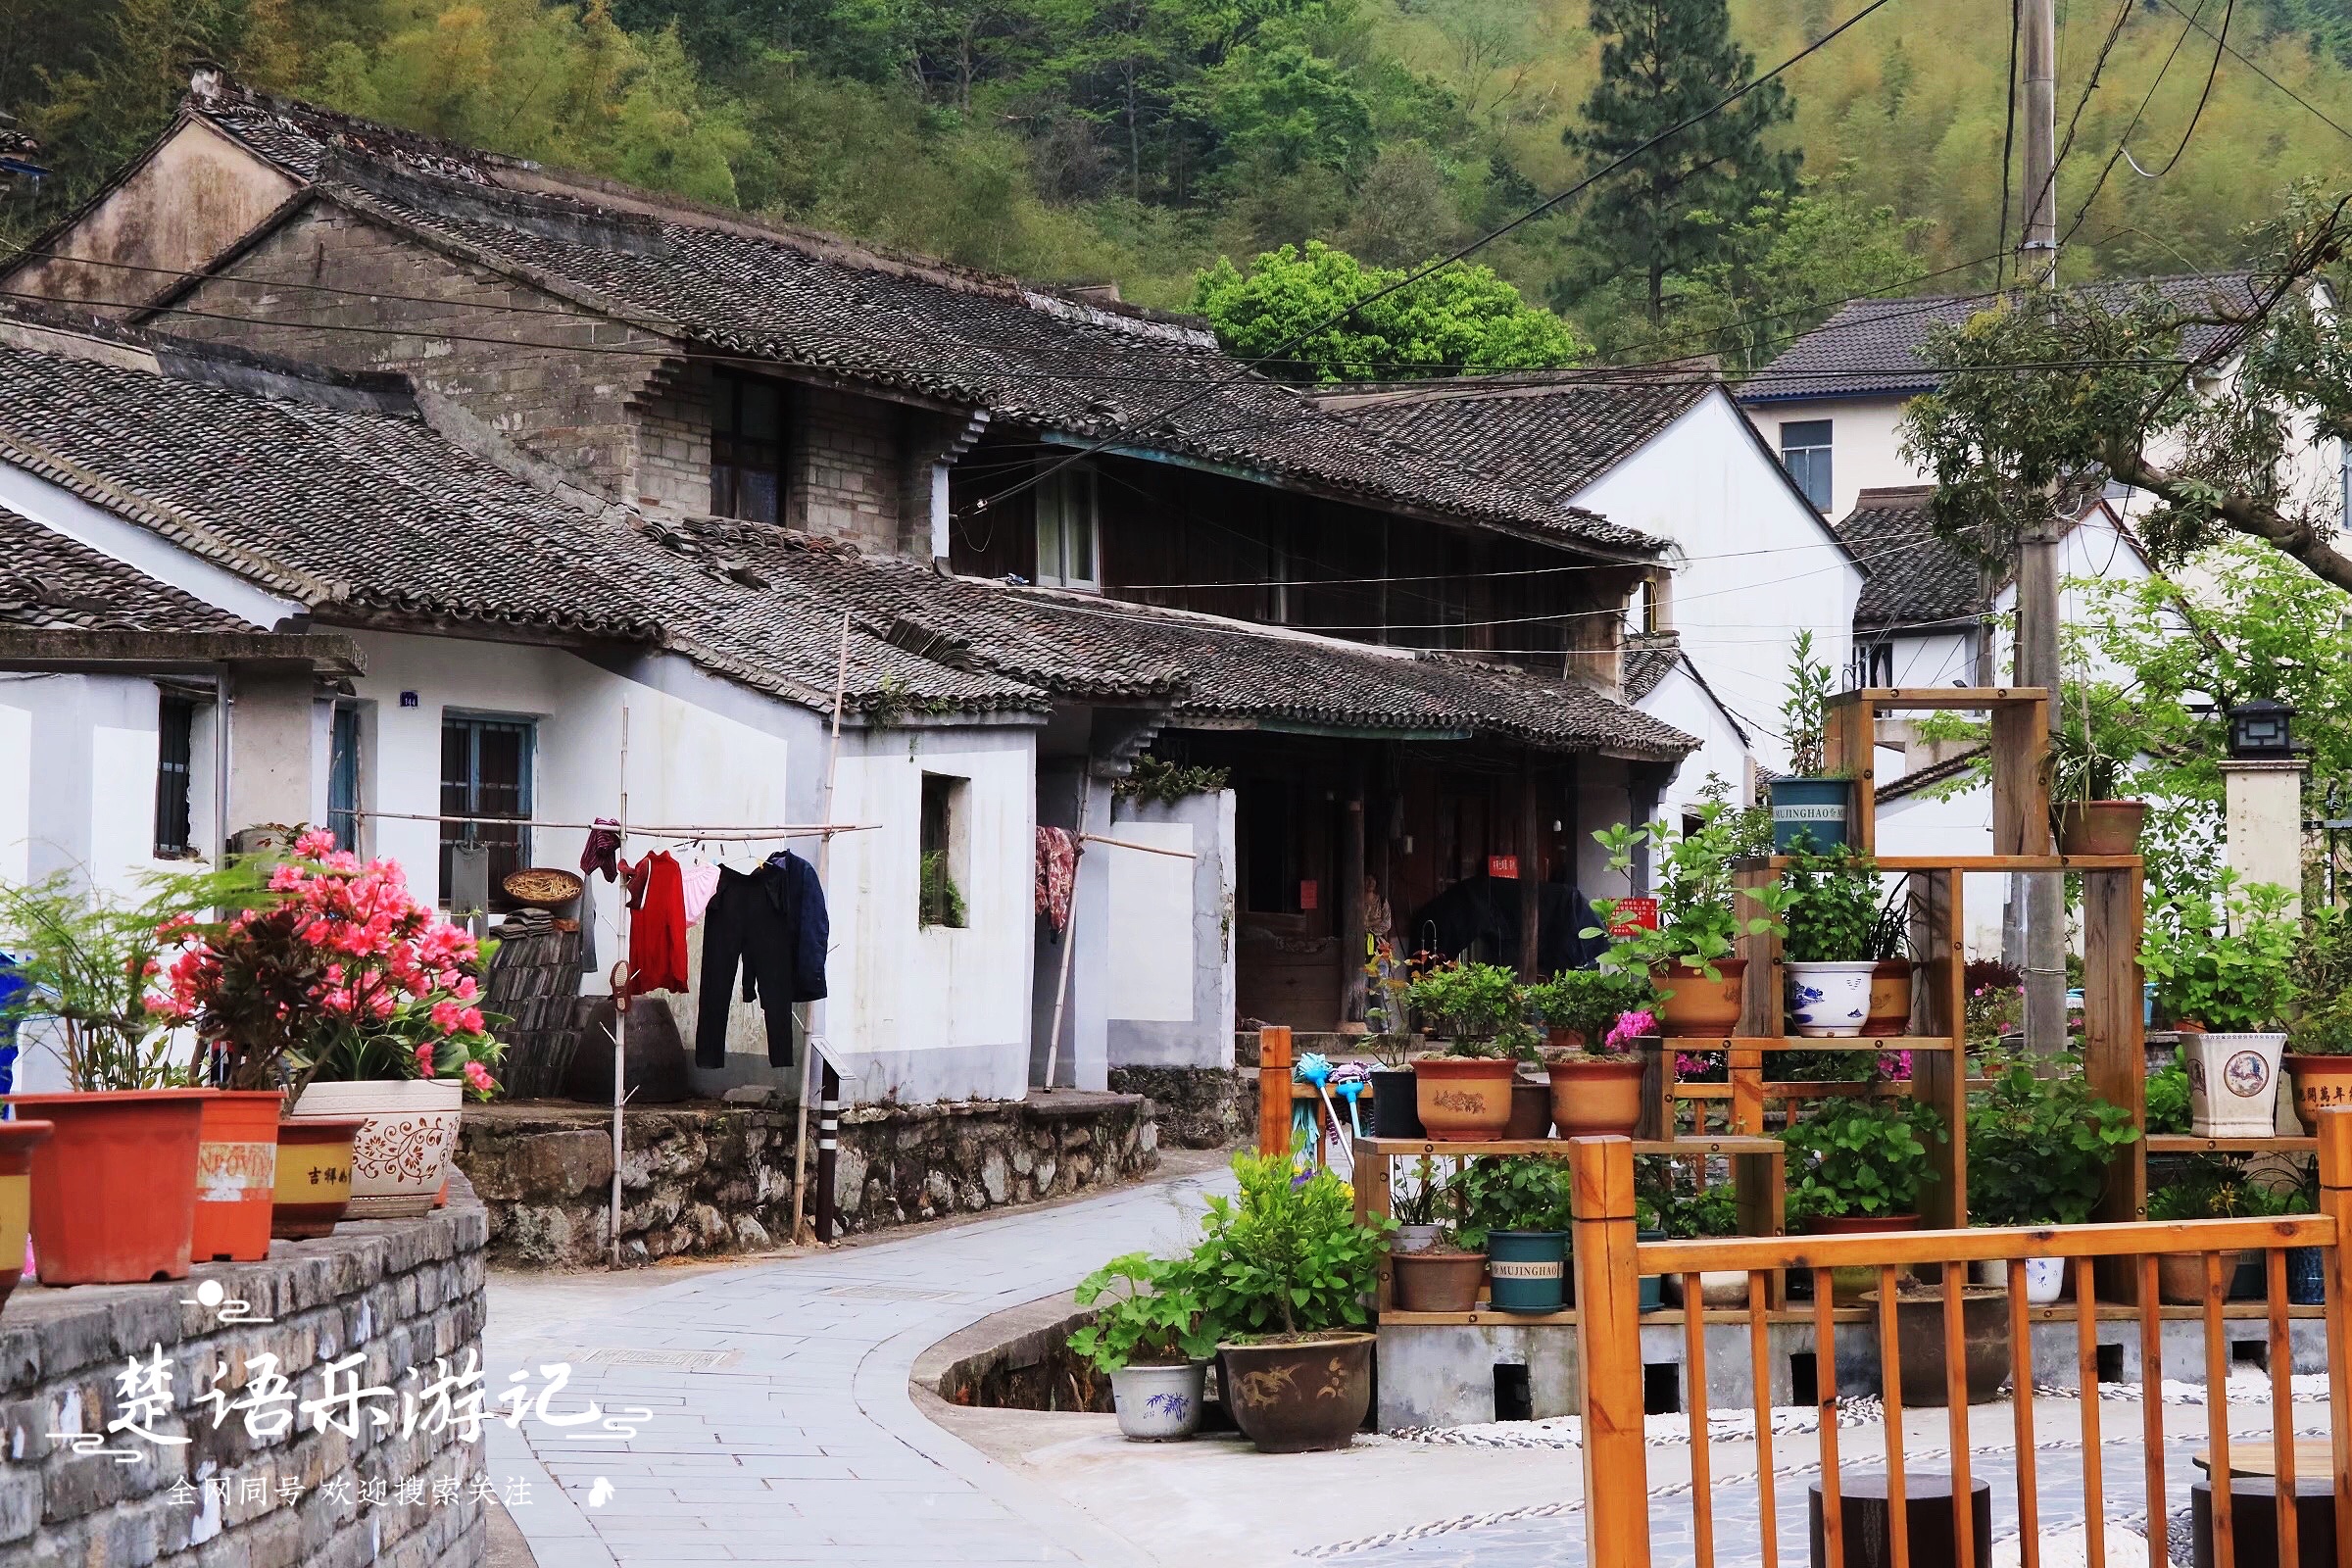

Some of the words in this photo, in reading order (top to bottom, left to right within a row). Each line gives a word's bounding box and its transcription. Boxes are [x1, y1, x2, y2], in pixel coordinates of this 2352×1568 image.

[1775, 808, 1829, 818] MUJINGHAO
[307, 1165, 352, 1186] 吉祥如
[1499, 1266, 1557, 1276] MUJINGHAO
